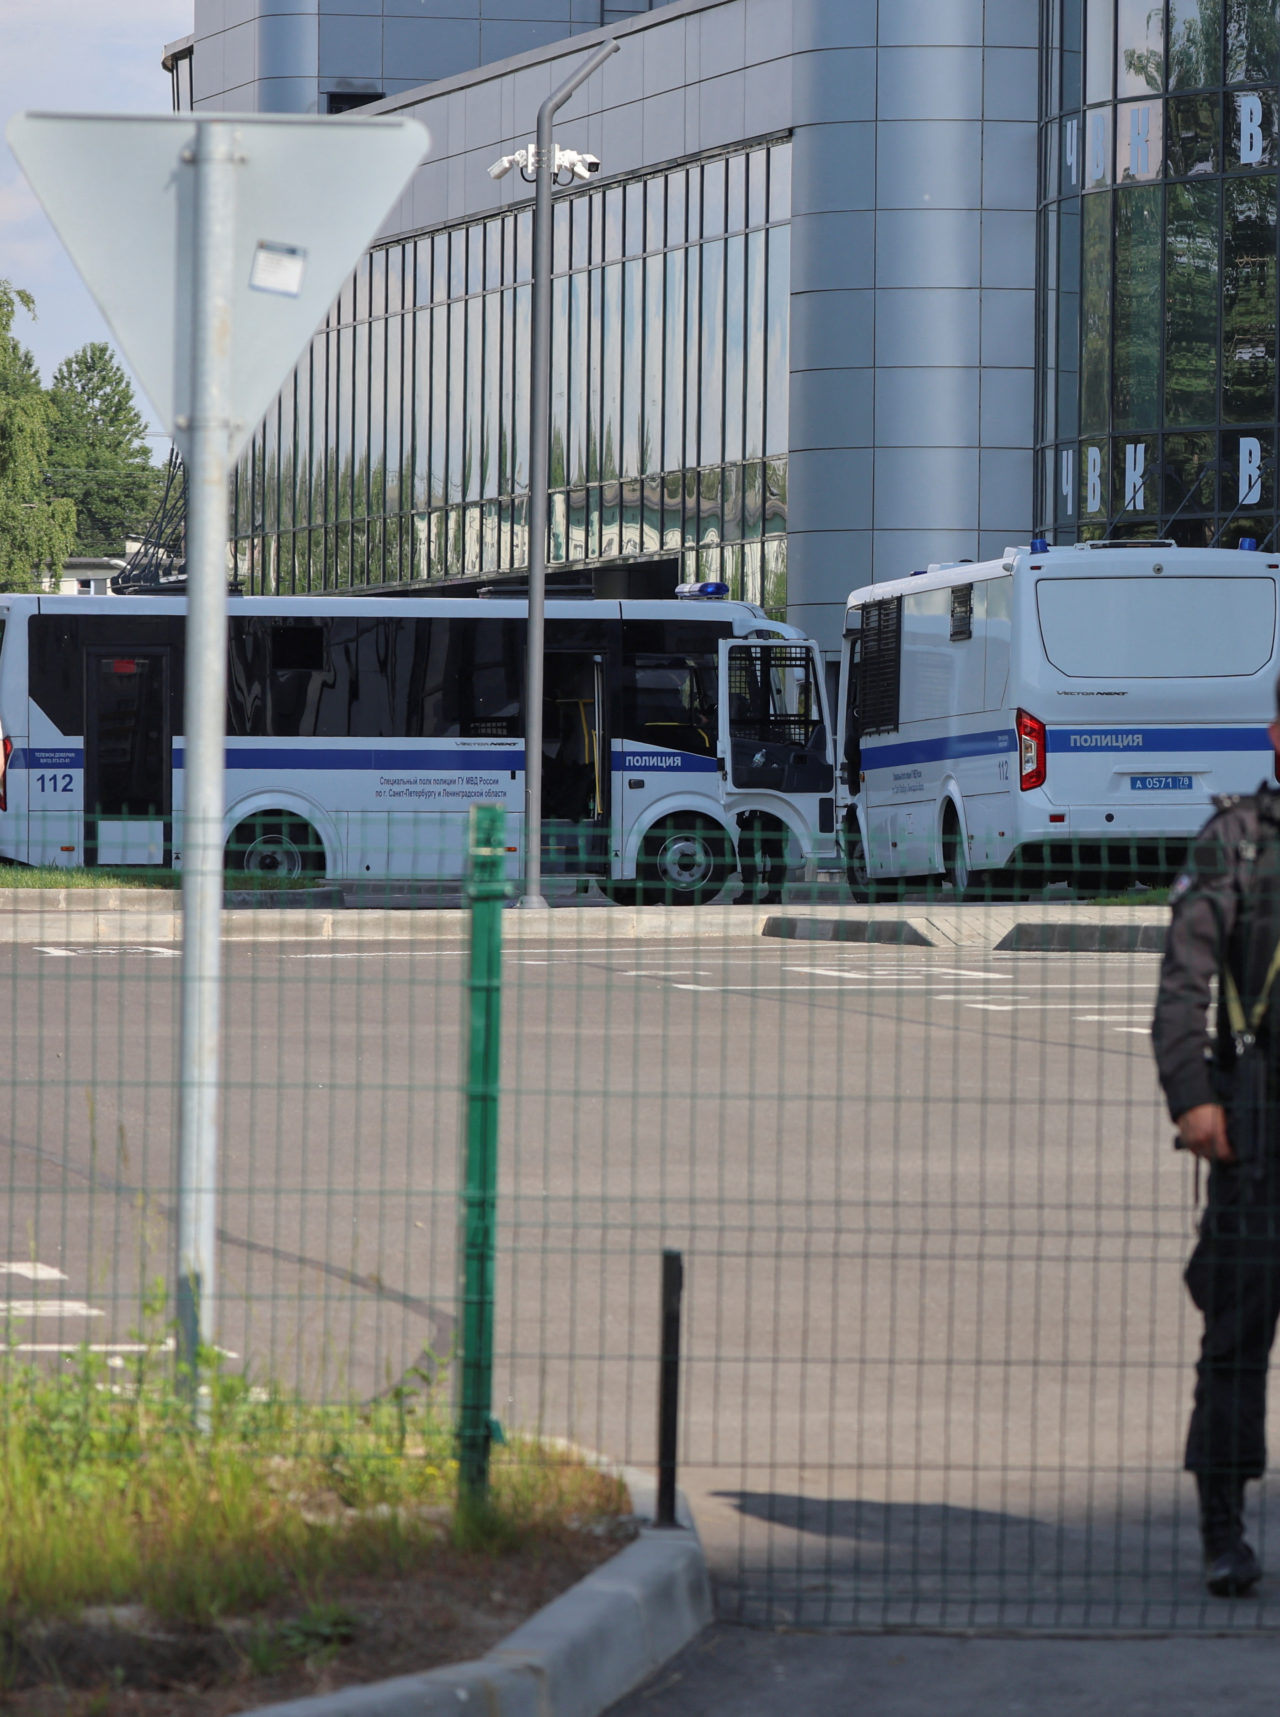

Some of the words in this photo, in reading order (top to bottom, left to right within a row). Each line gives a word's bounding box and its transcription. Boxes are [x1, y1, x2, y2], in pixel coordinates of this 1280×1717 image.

[1066, 107, 1149, 185] ЧВК
[1062, 443, 1145, 515] ЧВК
[1070, 734, 1143, 749] ПОЛИЦИЯ
[625, 756, 681, 768] ПОЛИЦИЯ
[36, 774, 74, 792] 112
[457, 777, 465, 785] ГУ
[465, 777, 478, 786] МВД
[479, 777, 499, 785] России
[1146, 778, 1173, 788] 0571
[1178, 777, 1189, 785] 78
